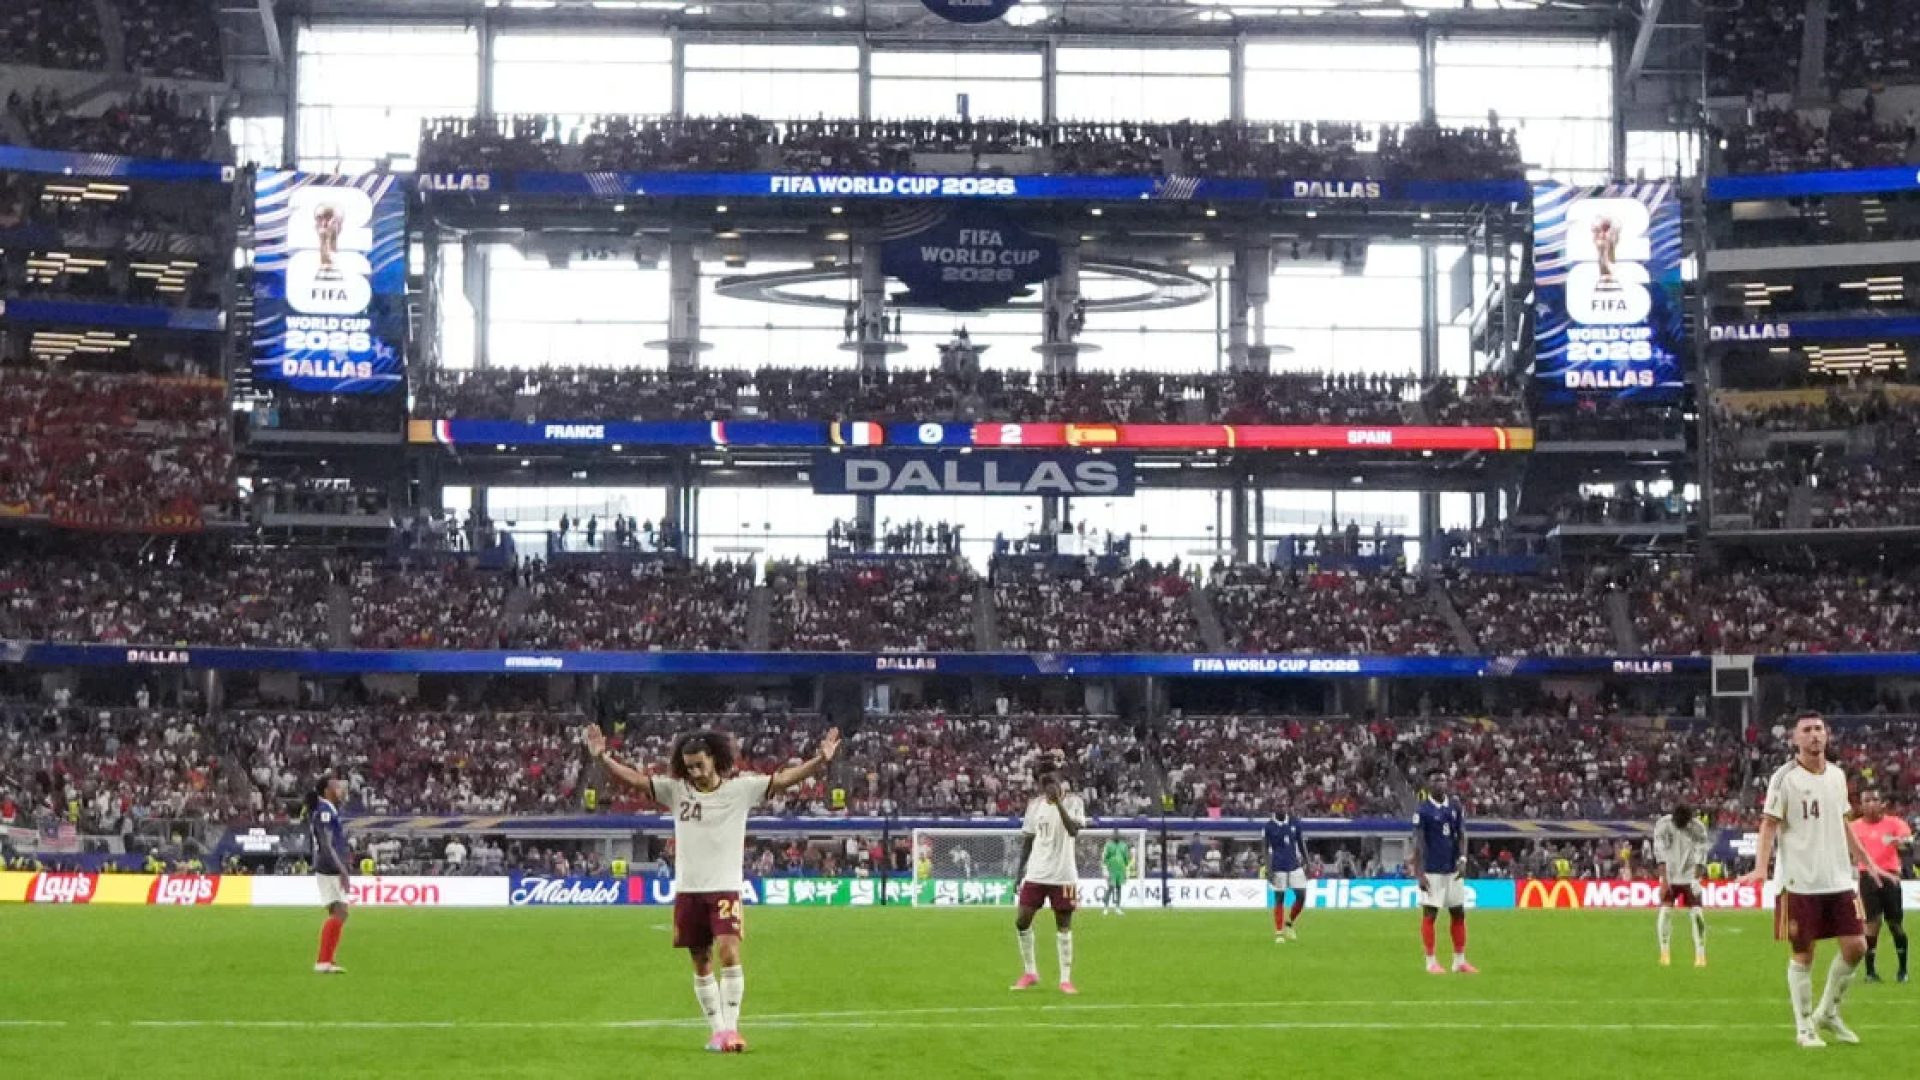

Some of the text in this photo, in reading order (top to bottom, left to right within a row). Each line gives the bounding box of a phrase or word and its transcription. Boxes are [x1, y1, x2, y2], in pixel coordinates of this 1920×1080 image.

[770, 176, 1017, 195] FIFA WORLD CUP 2026
[1293, 181, 1381, 198] DALLAS
[959, 229, 1003, 246] FIFA
[920, 246, 1040, 266] WORLD CUP
[942, 267, 1016, 282] 2026
[311, 287, 349, 301] FIFA
[1591, 299, 1628, 311] FIFA
[286, 316, 371, 332] WORLD CUP
[1709, 323, 1791, 341] DALLAS
[284, 330, 372, 352] 2026
[1566, 327, 1652, 341] WORLD CUP
[1566, 341, 1652, 361] 2026
[282, 359, 373, 378] DALLAS
[1565, 369, 1654, 388] DALLAS
[545, 424, 605, 439] FRANCE
[1000, 423, 1023, 445] 2
[1347, 430, 1392, 444] SPAIN
[845, 459, 1119, 493] DALLAS
[127, 649, 189, 663] DALLAS
[876, 657, 936, 669] DALLAS
[1192, 659, 1360, 672] FIFA WORLD CUP 2026
[1612, 660, 1673, 673] DALLAS
[679, 801, 702, 822] 24
[1801, 799, 1820, 820] 14
[1442, 822, 1450, 836] 8
[34, 872, 92, 903] Lay's
[155, 873, 213, 904] Lay's
[349, 876, 440, 905] erizon
[511, 877, 621, 904] Michelob
[1128, 885, 1232, 901] AMERICA
[1305, 879, 1477, 908] Hisene
